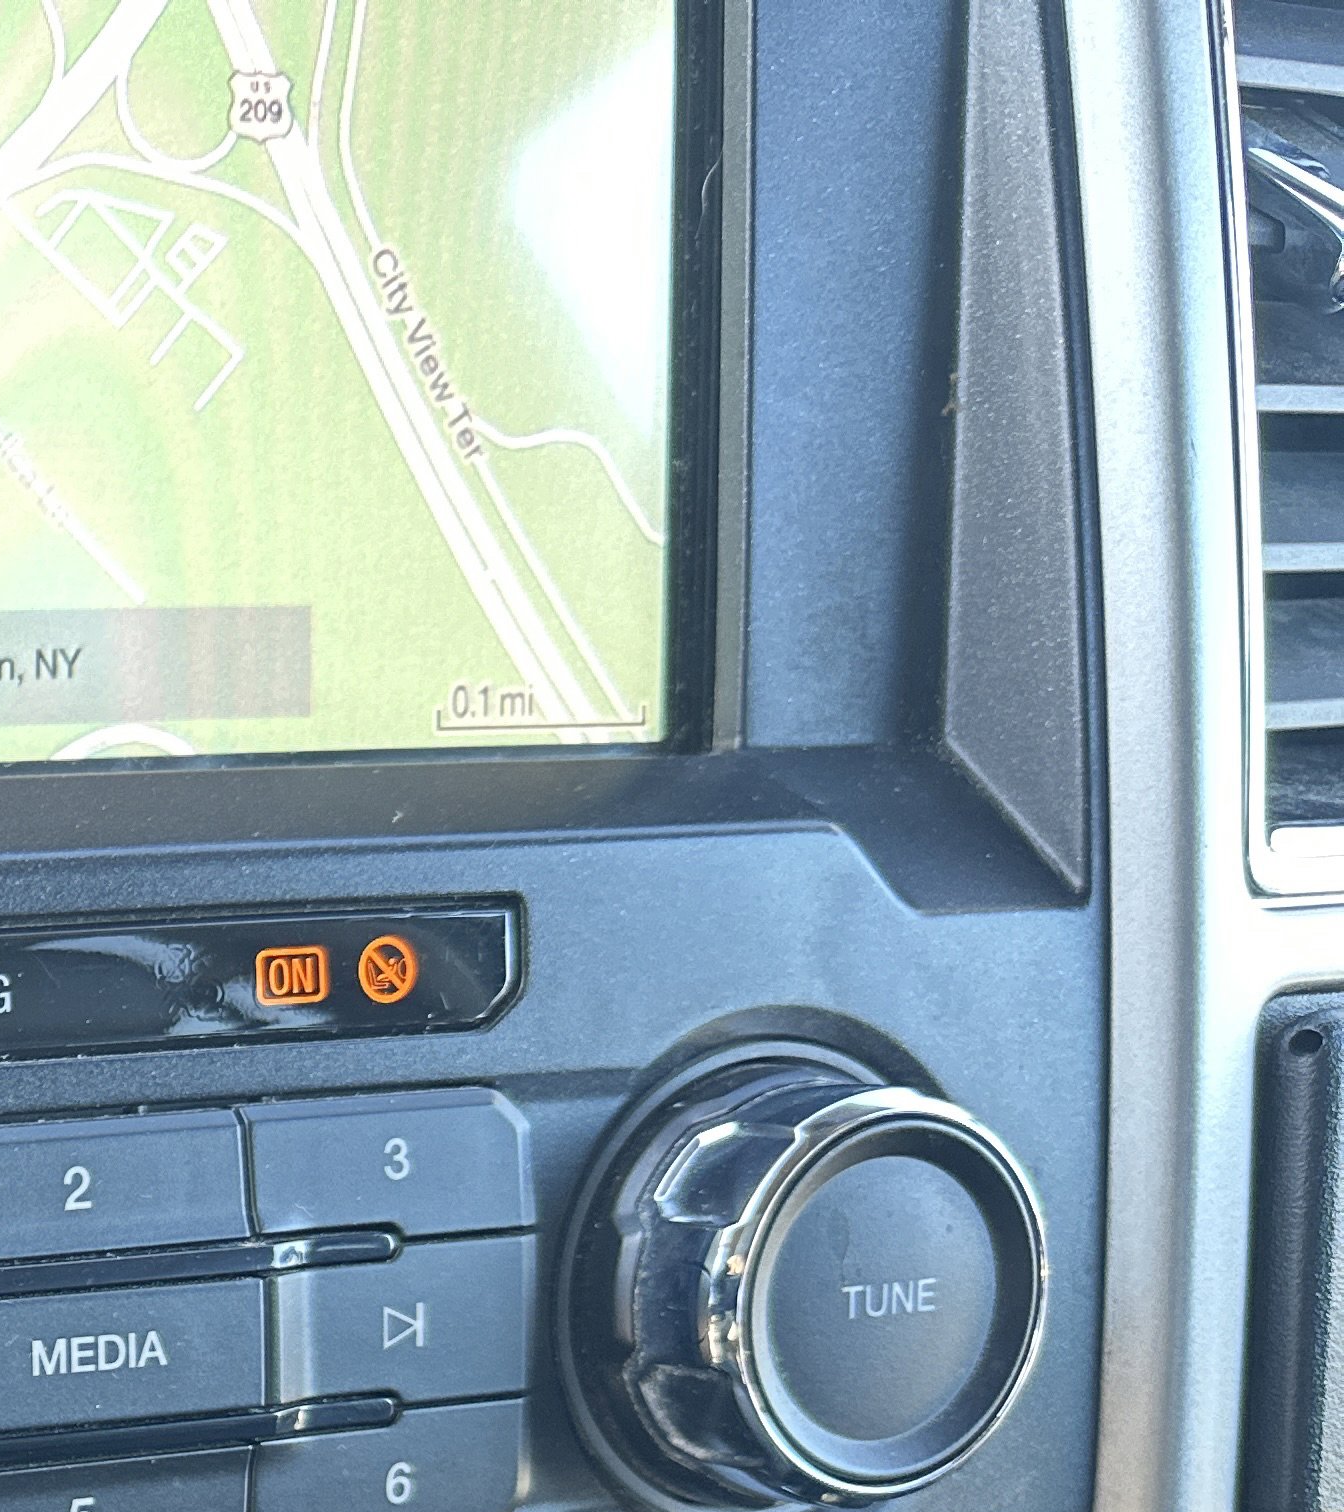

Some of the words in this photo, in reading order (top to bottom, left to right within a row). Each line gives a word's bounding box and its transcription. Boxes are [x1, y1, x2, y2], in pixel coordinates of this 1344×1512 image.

[239, 98, 283, 124] 209
[372, 249, 414, 316] City
[407, 317, 455, 402] View
[448, 401, 485, 460] Ter
[34, 647, 83, 681] NY
[451, 684, 490, 719] 0.1
[499, 683, 535, 717] mi
[267, 956, 315, 998] ON
[383, 1138, 412, 1182] 3
[63, 1165, 93, 1212] 2
[840, 1276, 937, 1320] TUNE
[31, 1330, 169, 1377] MEDIA
[384, 1463, 413, 1506] 6
